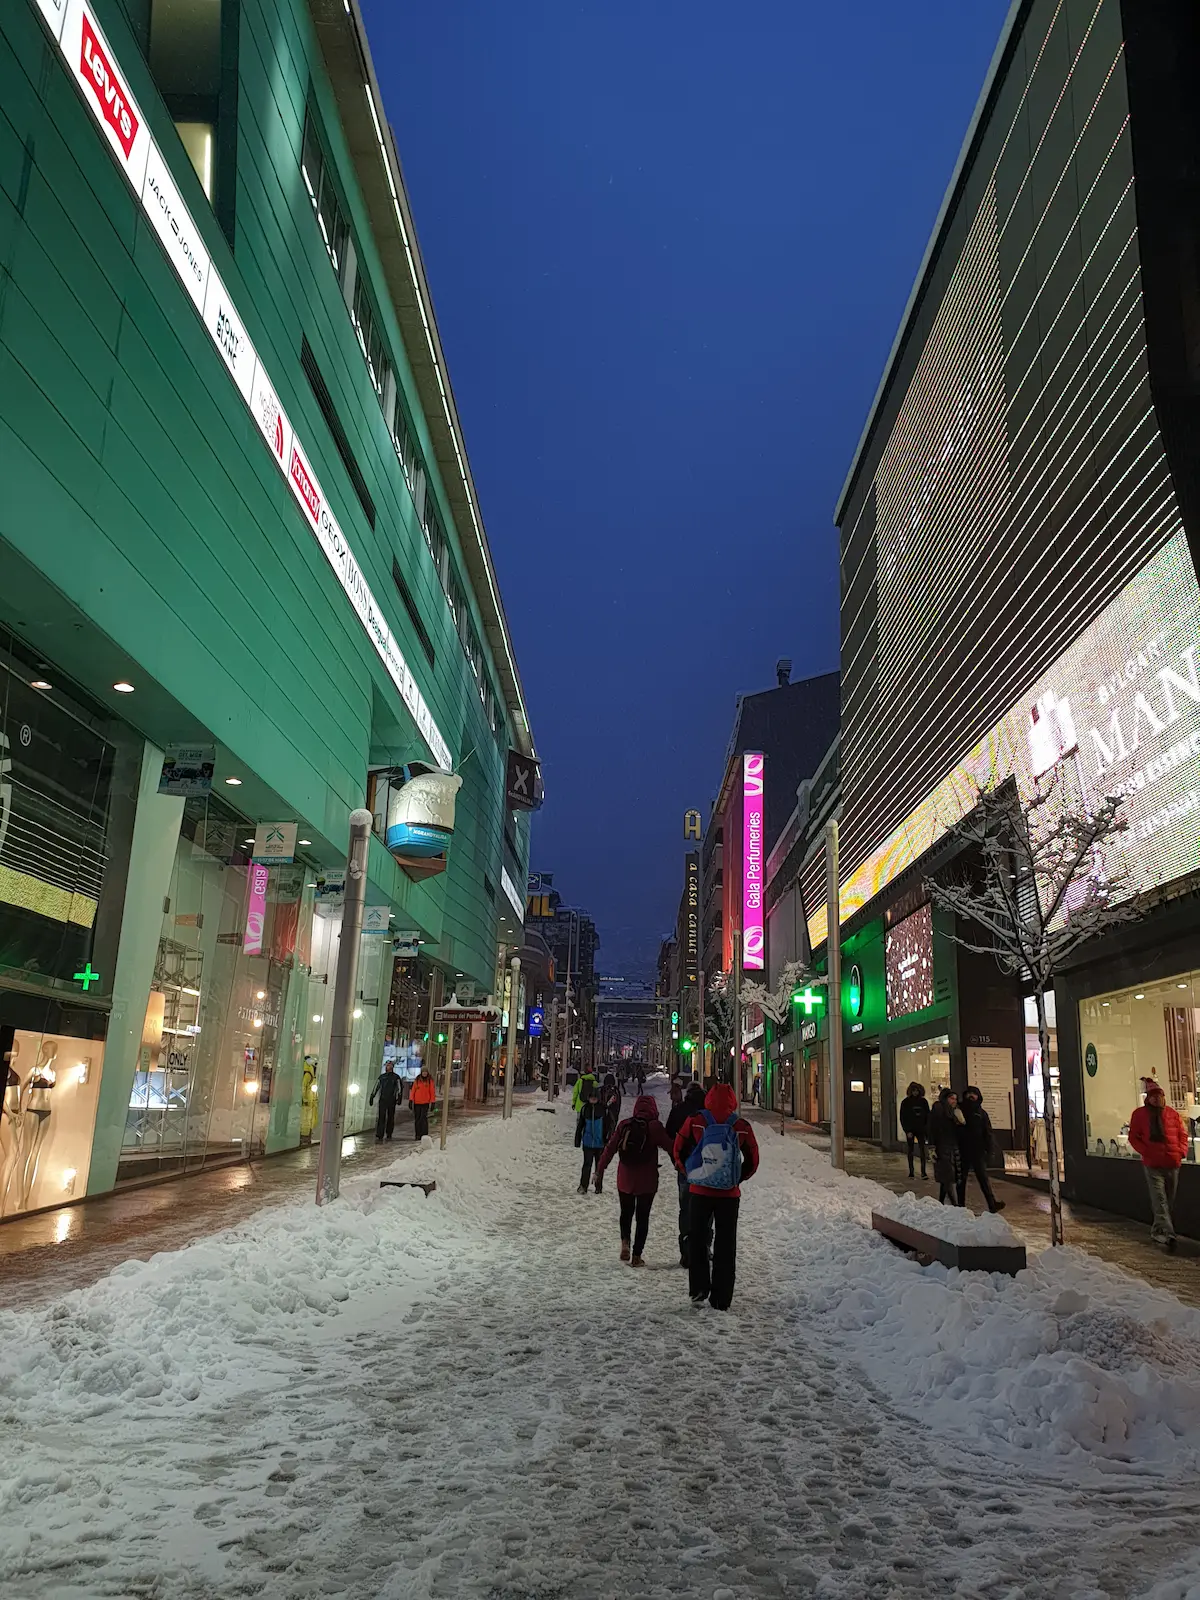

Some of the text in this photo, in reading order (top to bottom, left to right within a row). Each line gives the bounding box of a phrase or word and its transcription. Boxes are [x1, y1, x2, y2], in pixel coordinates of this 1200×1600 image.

[148, 178, 203, 282] JACK JONES
[216, 320, 237, 370] BLANC
[218, 304, 239, 351] MONT
[321, 510, 347, 565] GEOX
[347, 558, 368, 611] BOSS
[689, 863, 698, 872] a
[746, 811, 761, 909] Gala Perfumeries
[688, 876, 698, 906] casa
[688, 913, 698, 955] canut
[168, 1052, 189, 1067] ONLY
[979, 1035, 991, 1043] 115
